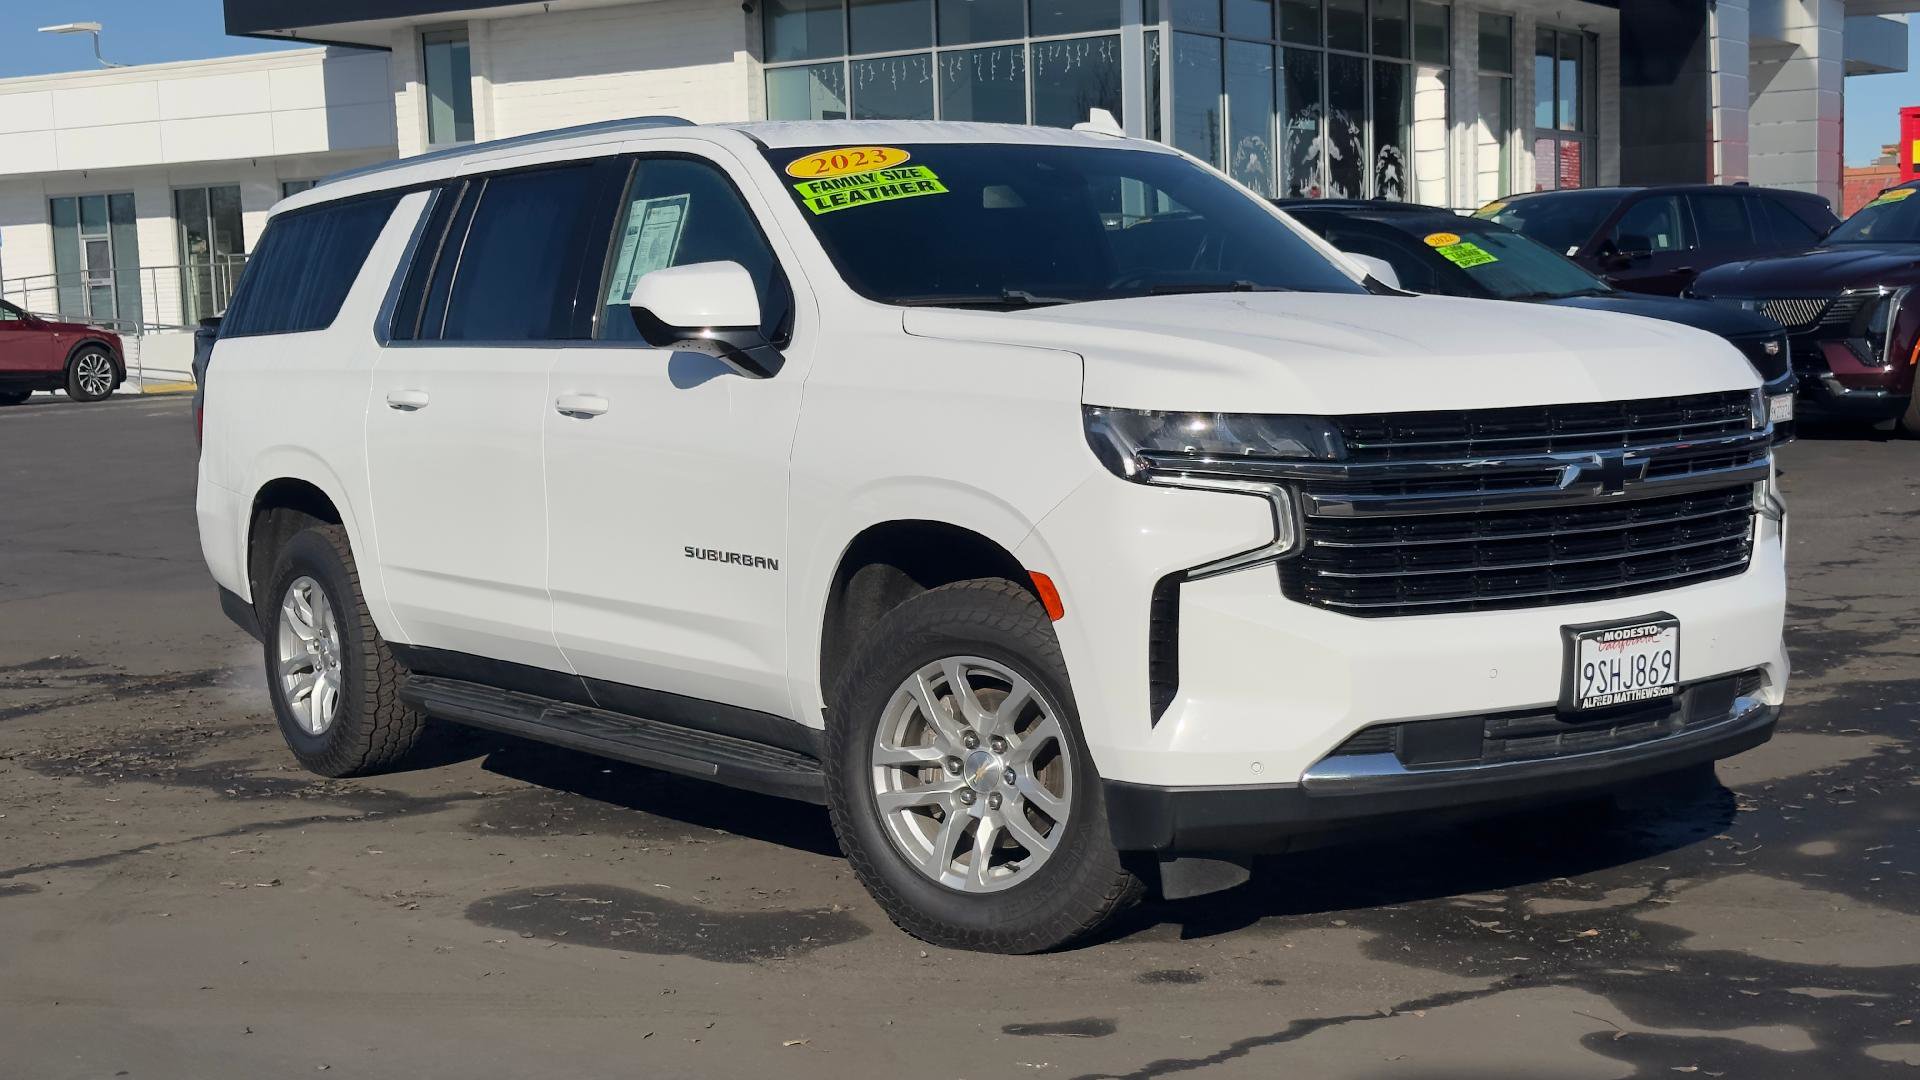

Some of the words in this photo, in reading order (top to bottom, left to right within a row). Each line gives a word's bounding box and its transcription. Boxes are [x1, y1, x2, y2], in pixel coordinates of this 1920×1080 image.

[811, 149, 888, 175] 2023
[808, 172, 877, 194] FAMILY
[880, 168, 922, 181] SIZE
[814, 180, 936, 210] LEATHER
[684, 545, 779, 571] SUBURBAN
[1603, 625, 1658, 642] MODESTO
[1583, 649, 1672, 698] 9SHJ869
[1582, 694, 1613, 709] ALFRED
